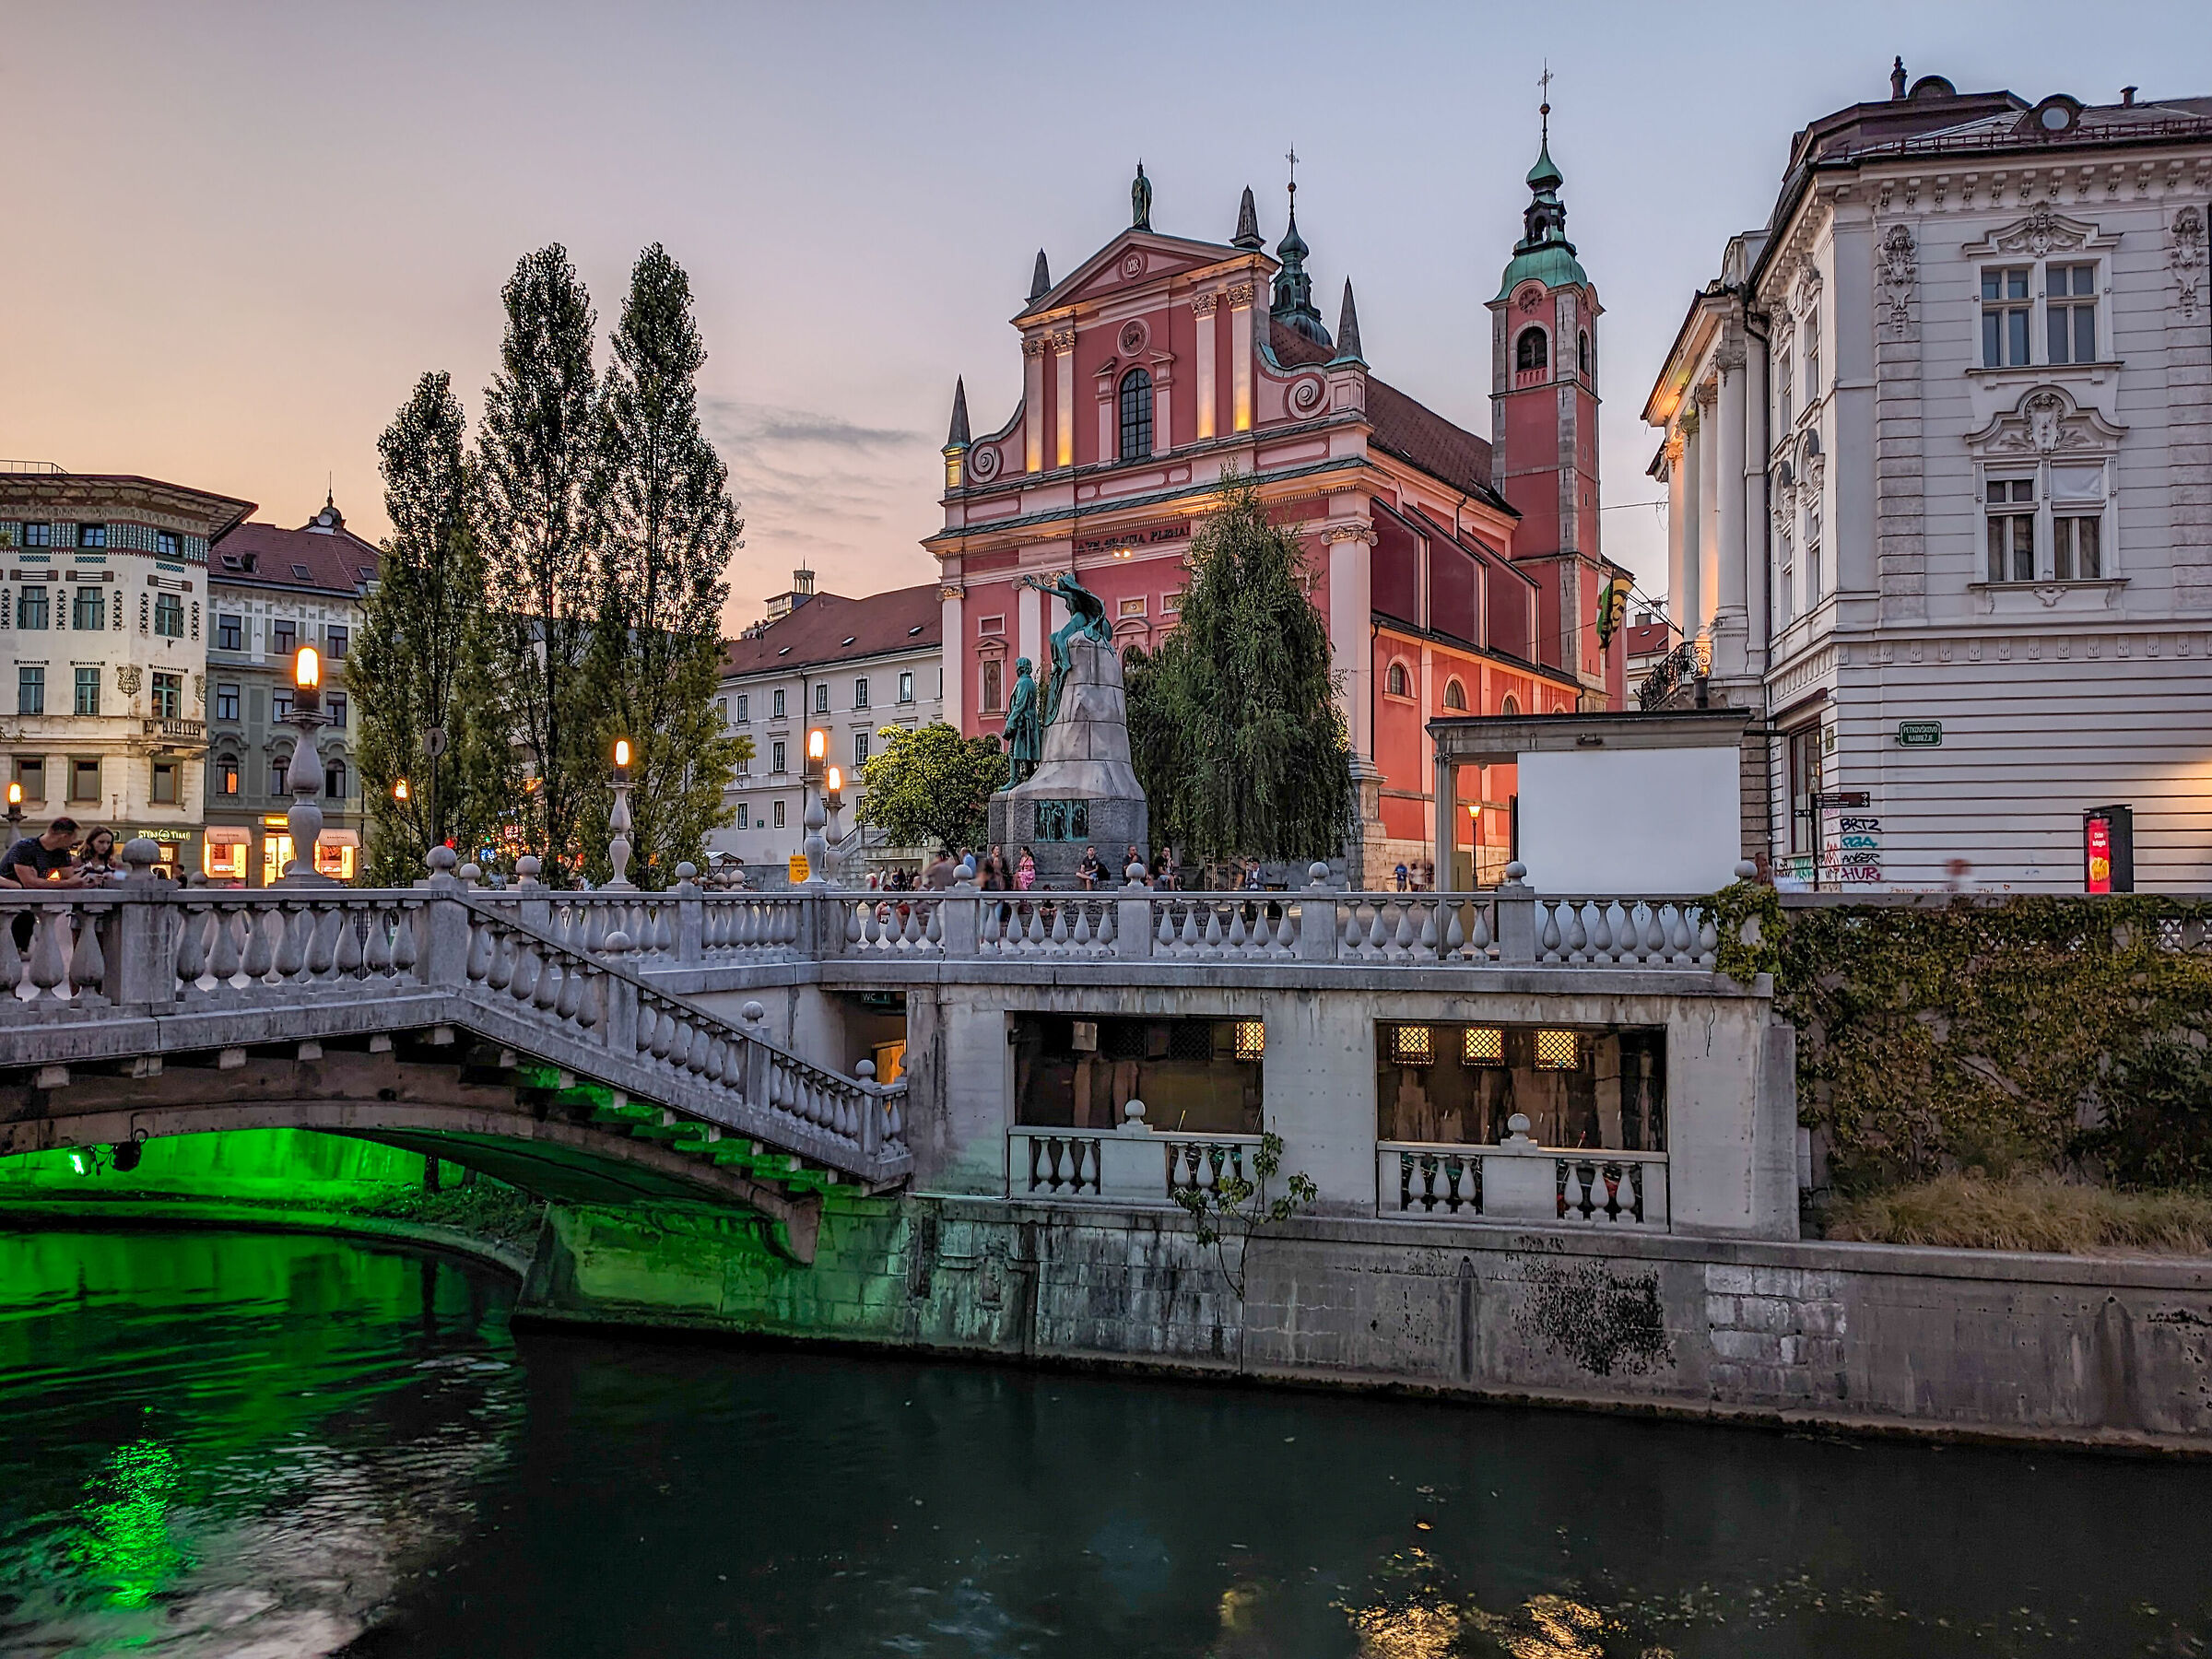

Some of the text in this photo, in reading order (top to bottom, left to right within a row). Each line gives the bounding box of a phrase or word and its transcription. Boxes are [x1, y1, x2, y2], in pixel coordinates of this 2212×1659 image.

[1903, 725, 1938, 734] PETKOVŠKOVO
[1908, 734, 1934, 742] NABREŽJE
[862, 993, 877, 1001] WC
